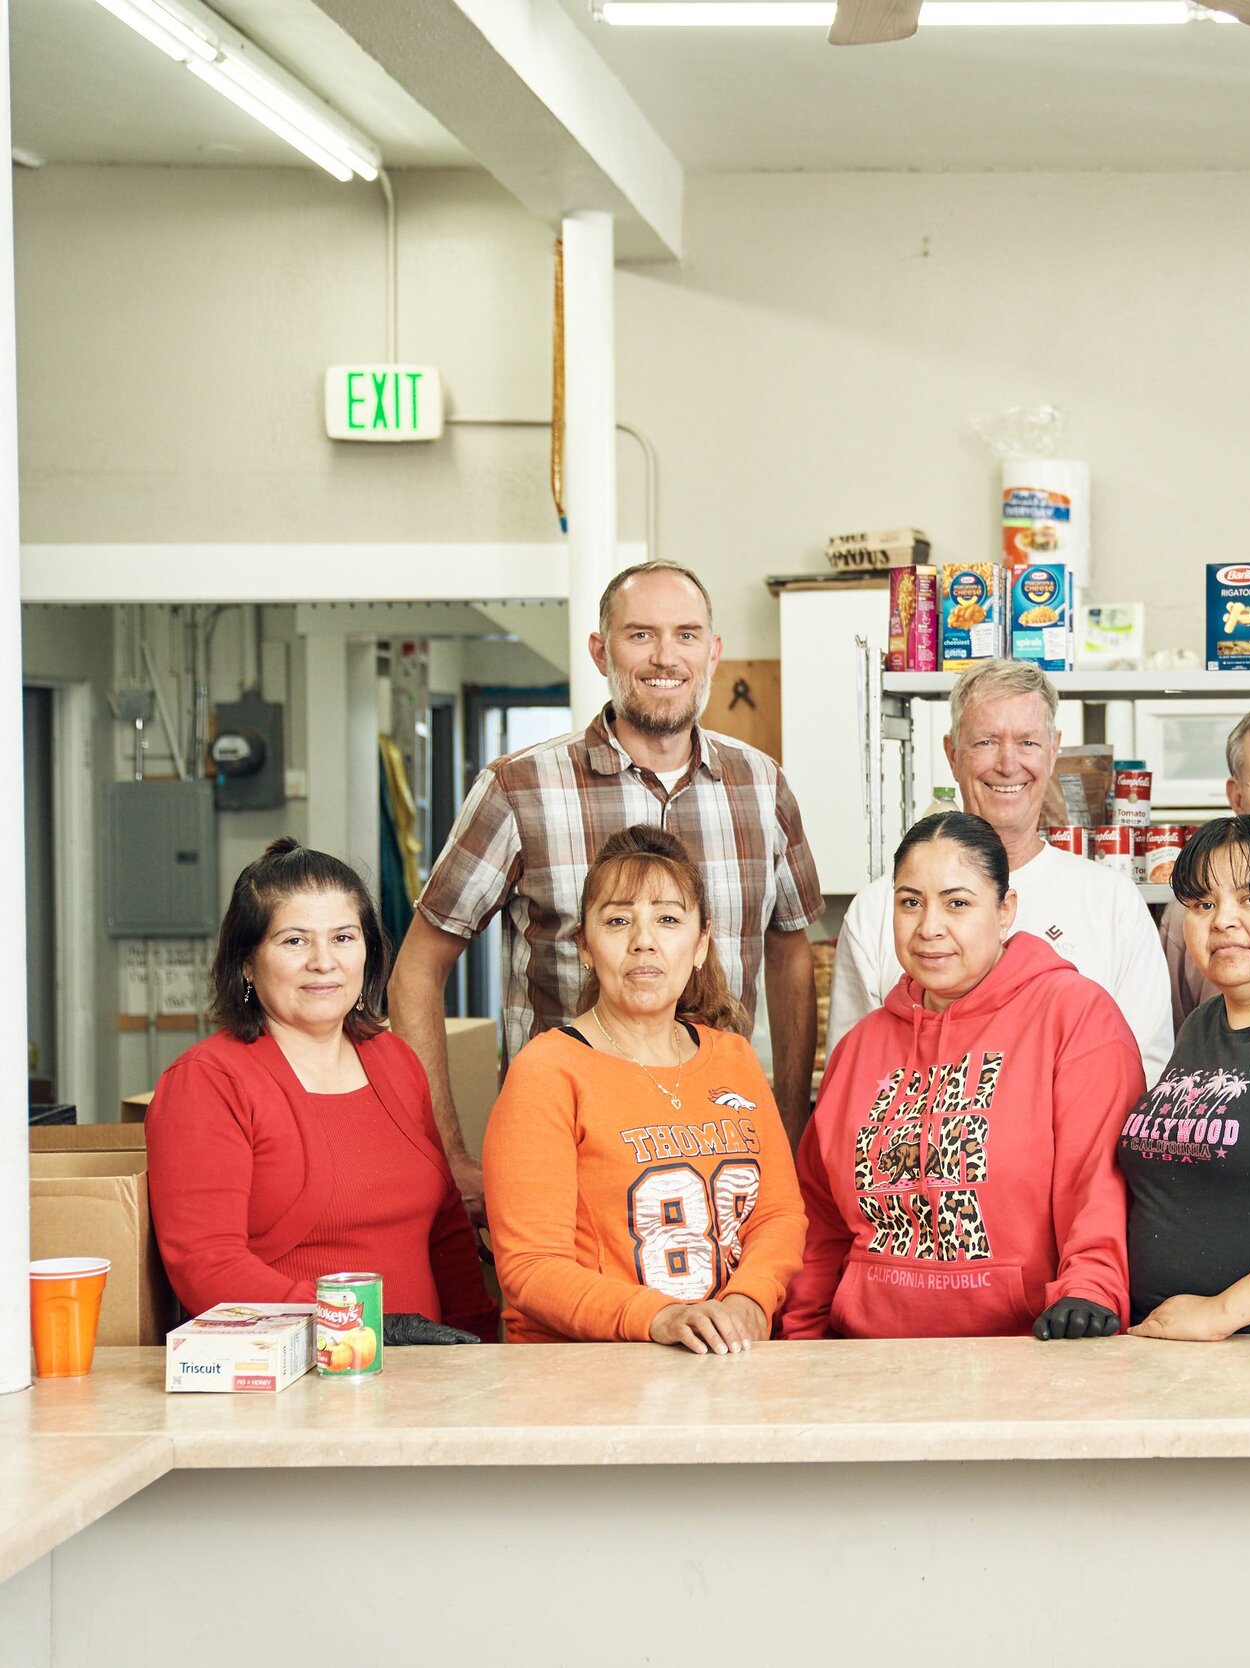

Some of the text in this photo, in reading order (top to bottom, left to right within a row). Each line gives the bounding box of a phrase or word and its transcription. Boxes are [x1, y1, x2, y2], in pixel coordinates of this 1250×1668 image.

[348, 372, 423, 429] EXIT
[1016, 636, 1043, 647] spirals
[1117, 808, 1146, 818] Tomato
[620, 1118, 761, 1163] THOMAS
[1130, 1137, 1212, 1157] CALIFORNIA
[1141, 1151, 1198, 1164] U.S.A.
[857, 1189, 994, 1263] NIA
[867, 1264, 992, 1290] CALIFORNIA REPUBLIC
[179, 1361, 221, 1374] Triscuit
